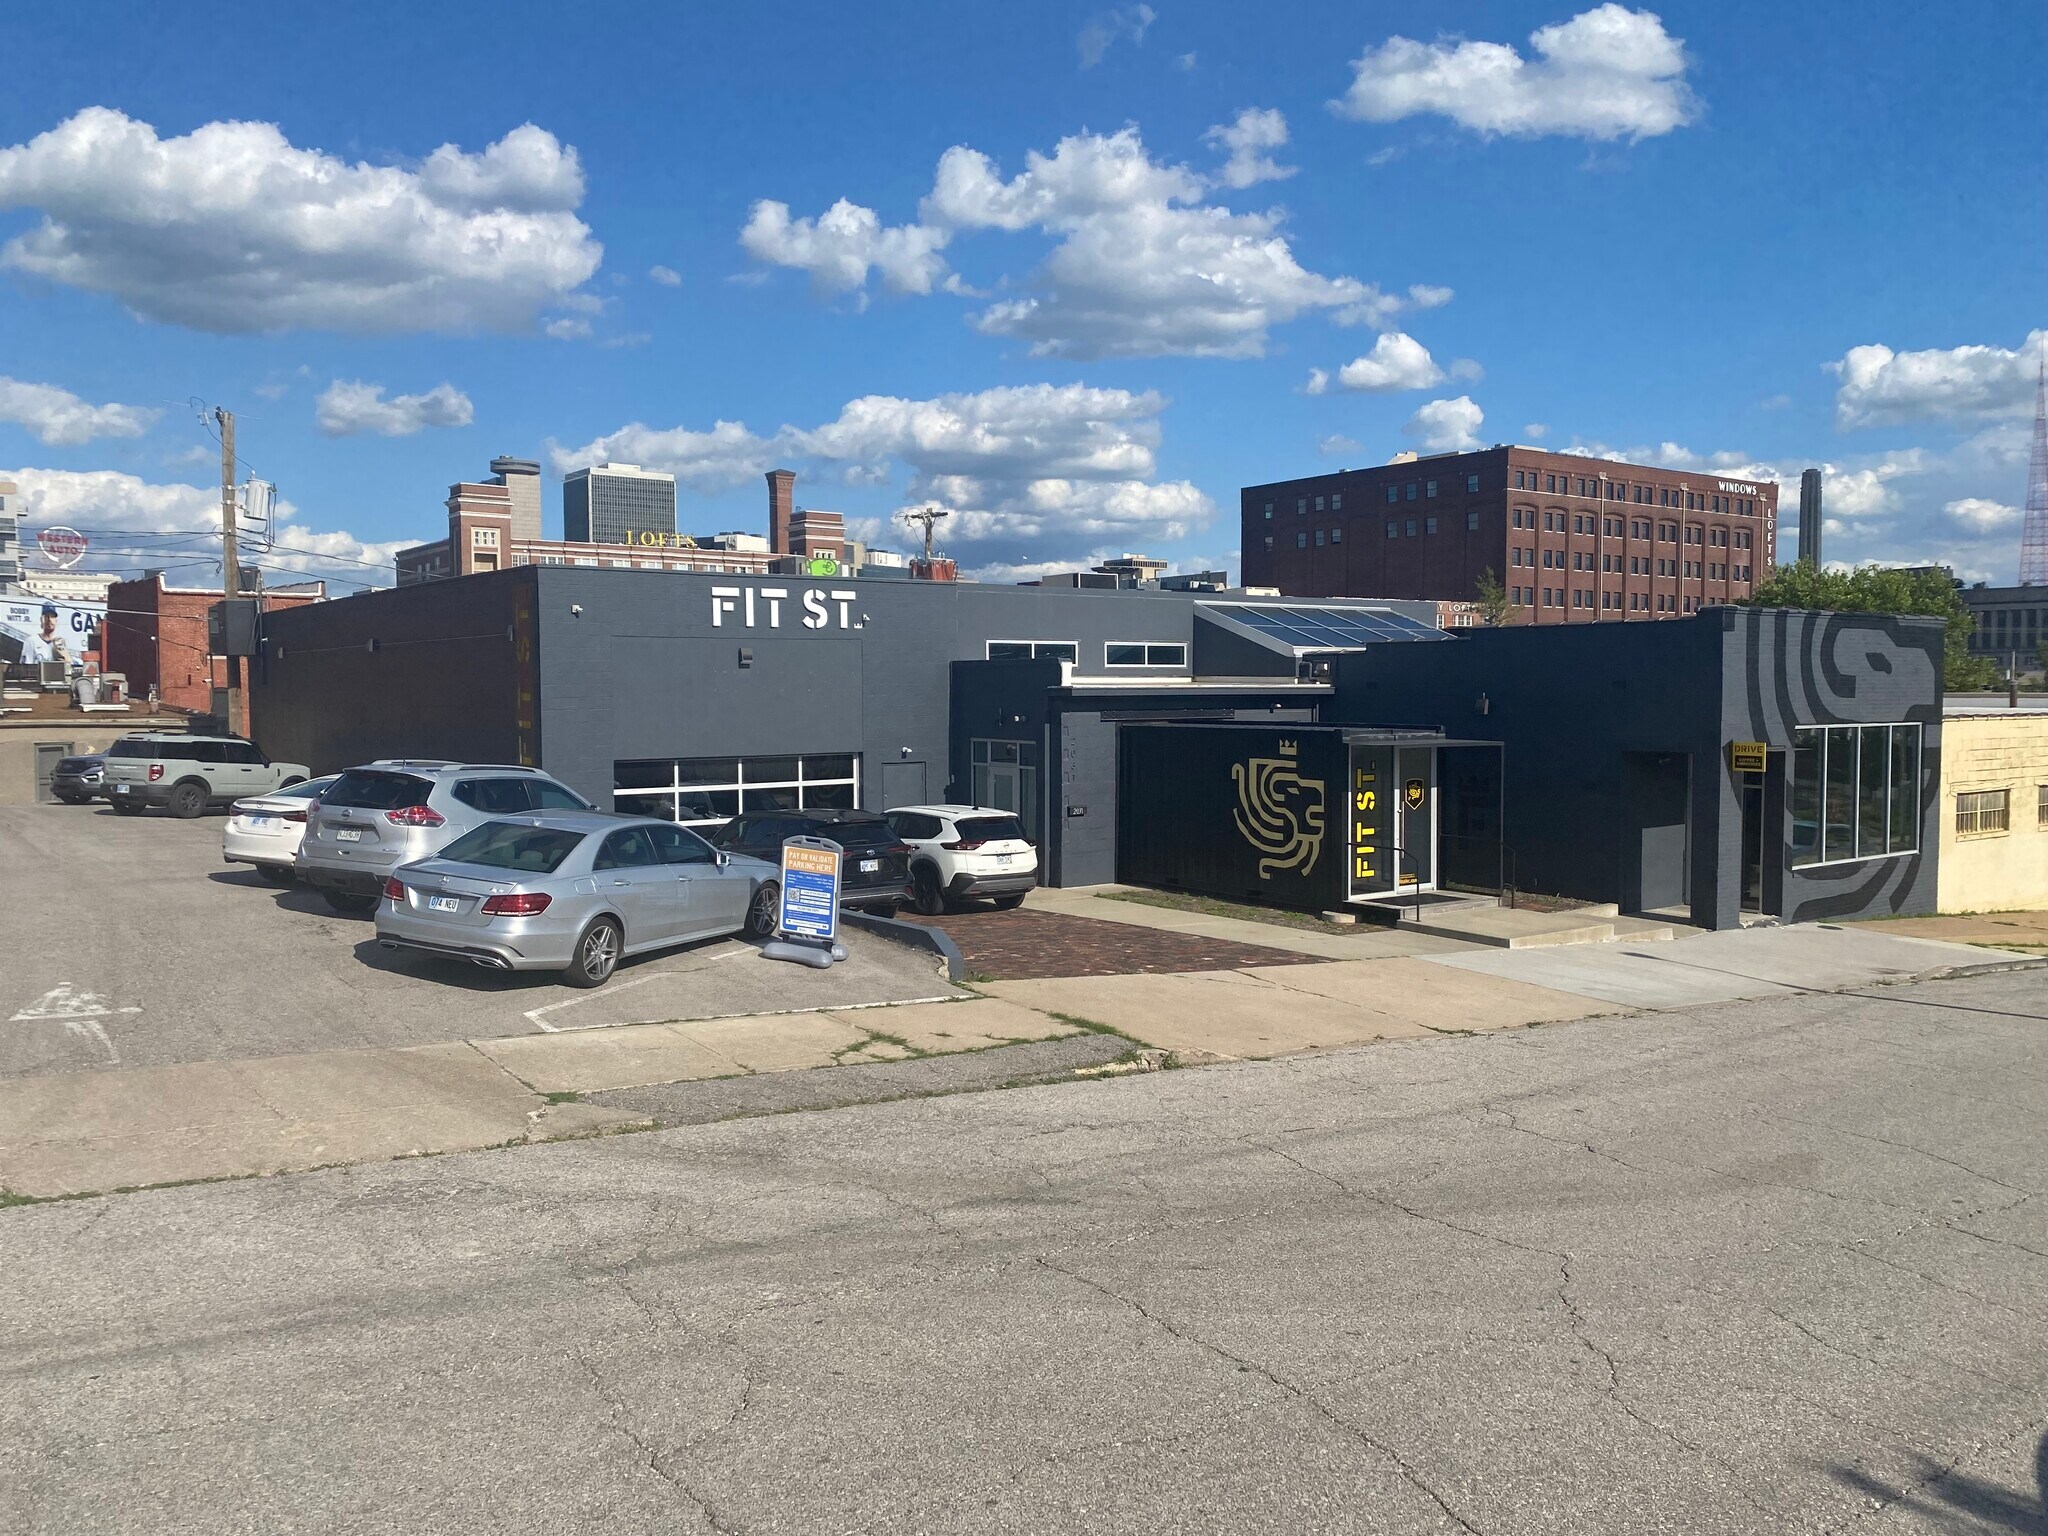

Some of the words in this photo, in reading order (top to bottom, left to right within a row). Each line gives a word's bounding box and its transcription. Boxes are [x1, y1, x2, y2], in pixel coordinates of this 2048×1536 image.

[1718, 481, 1757, 495] WINDOWS
[626, 530, 698, 549] LOFTS
[50, 545, 78, 555] AUTO
[10, 607, 29, 615] BOBBY
[711, 586, 788, 628] FIT
[1734, 745, 1763, 754] DRIVE
[1356, 822, 1375, 878] FIT
[789, 851, 801, 860] PAY
[801, 853, 809, 861] OR
[809, 854, 834, 864] VALIDATE
[788, 860, 816, 870] PARKING
[816, 863, 833, 873] HERE
